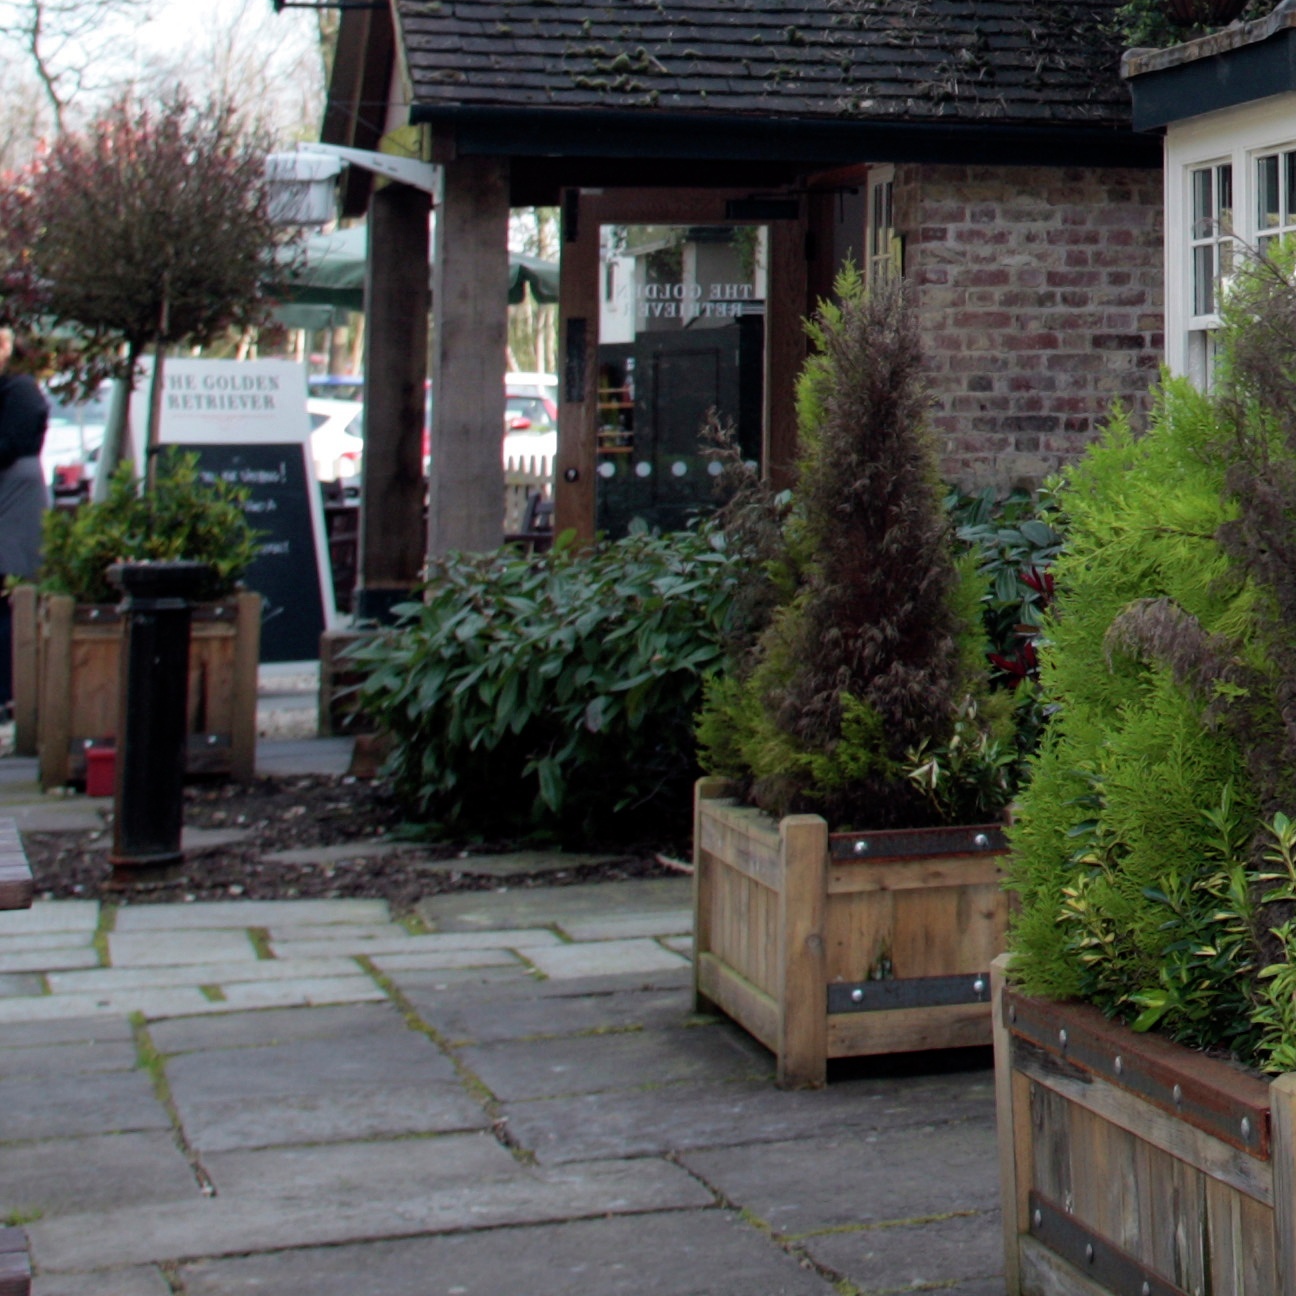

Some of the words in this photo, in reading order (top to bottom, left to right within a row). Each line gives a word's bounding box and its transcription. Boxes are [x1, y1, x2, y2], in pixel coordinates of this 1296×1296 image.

[160, 374, 196, 391] HE
[201, 374, 281, 391] GOLDEN
[166, 393, 277, 411] RETRIEVER
